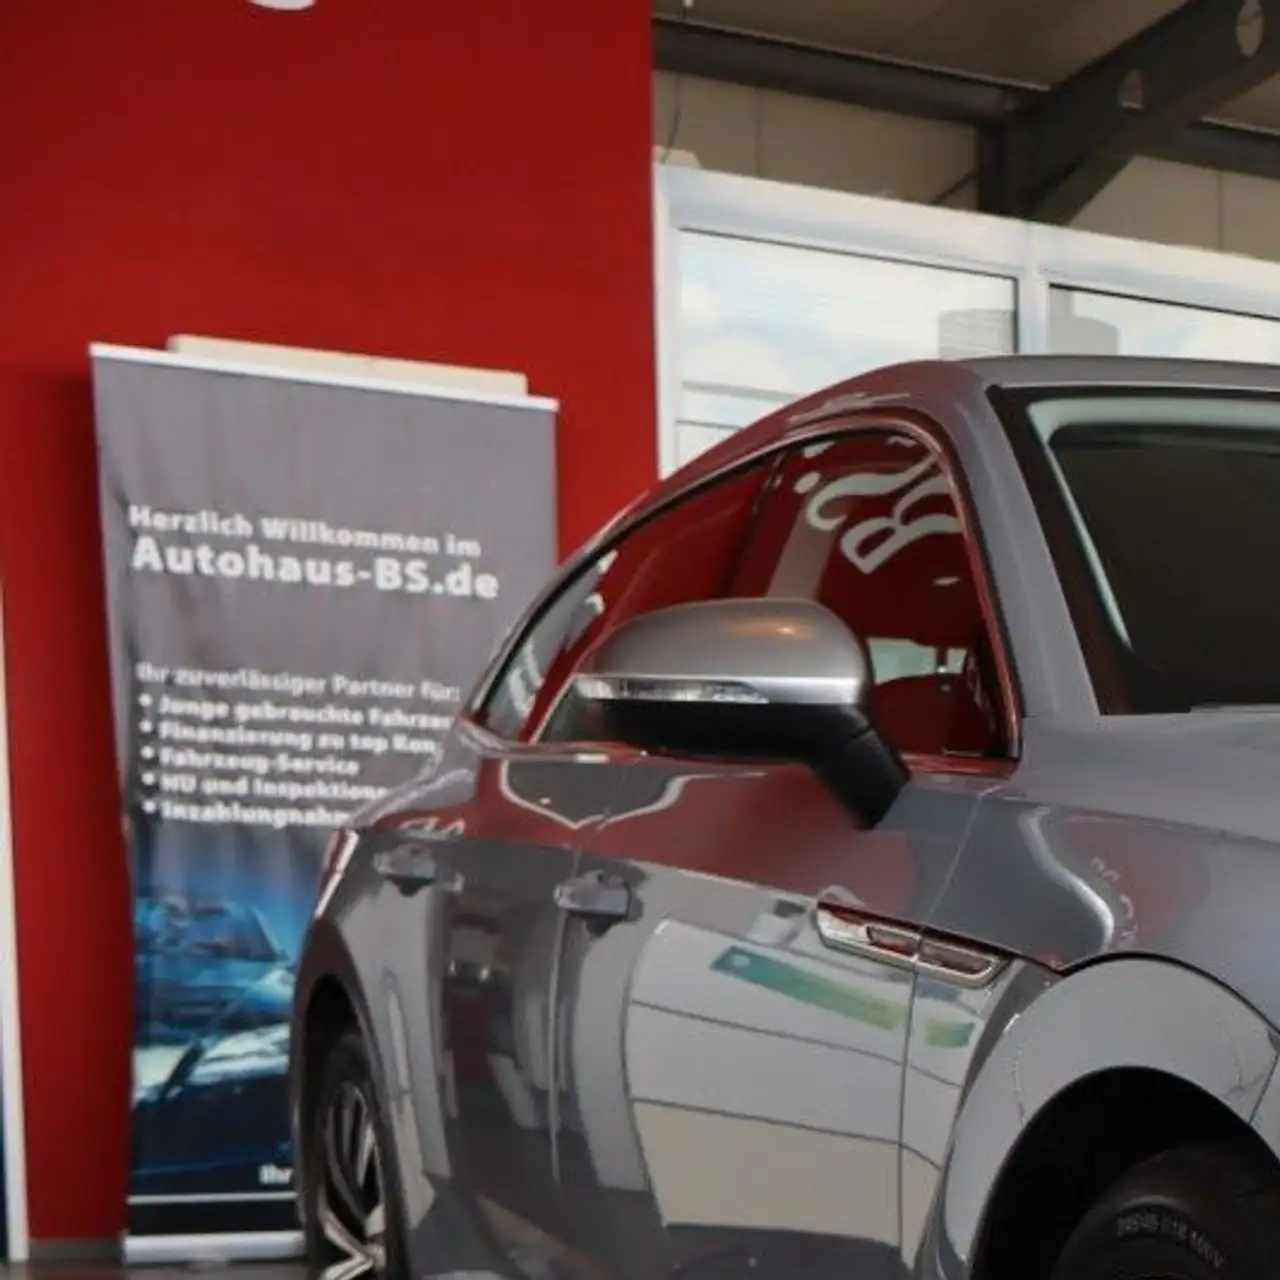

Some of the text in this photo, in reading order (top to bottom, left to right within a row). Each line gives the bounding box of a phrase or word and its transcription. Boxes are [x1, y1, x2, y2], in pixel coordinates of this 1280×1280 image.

[129, 505, 481, 557] Herzlich Willkommen im
[132, 536, 500, 598] Autohaus-BS.de
[136, 661, 167, 685] Ihr
[174, 669, 328, 697] zuverlässiger
[332, 674, 415, 699] Partner
[159, 695, 229, 720] Junge
[234, 701, 363, 726] gebrauchte
[158, 721, 312, 749] Finanzierung
[318, 733, 345, 749] zu
[350, 733, 388, 755] top
[159, 747, 360, 777] Fahrzeug-Service
[159, 773, 197, 794] HU
[202, 775, 248, 797] und
